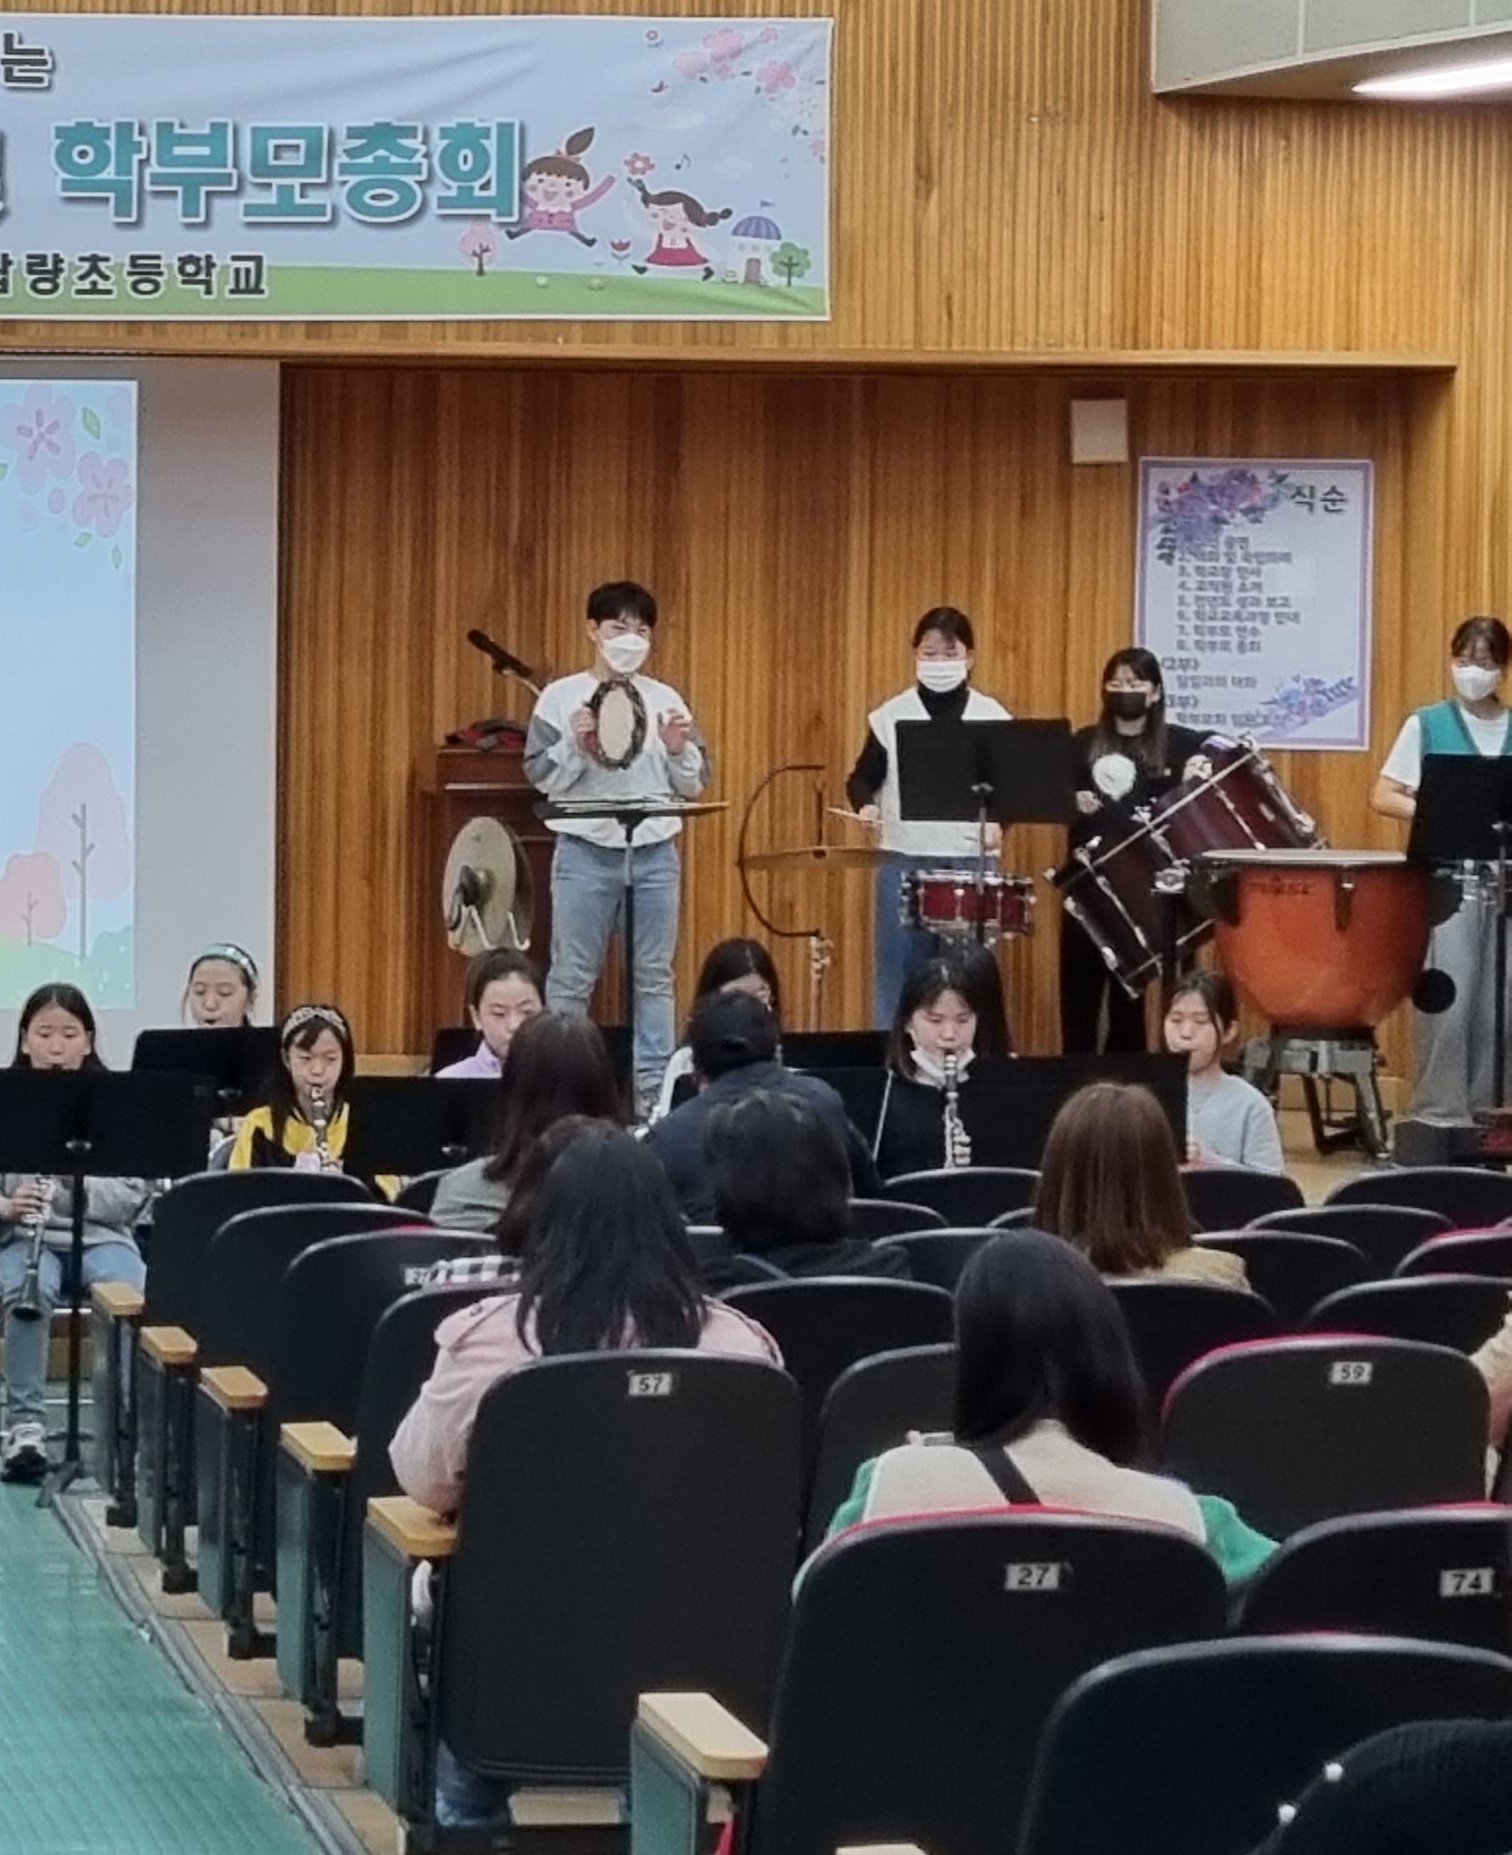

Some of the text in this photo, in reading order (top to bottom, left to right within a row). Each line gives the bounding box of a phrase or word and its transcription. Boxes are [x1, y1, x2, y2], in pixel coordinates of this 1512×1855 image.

[53, 119, 519, 222] 학부모총회
[1290, 484, 1348, 514] 식순
[638, 1376, 664, 1392] 57
[1017, 1565, 1051, 1586] 27
[1452, 1573, 1483, 1593] 74
